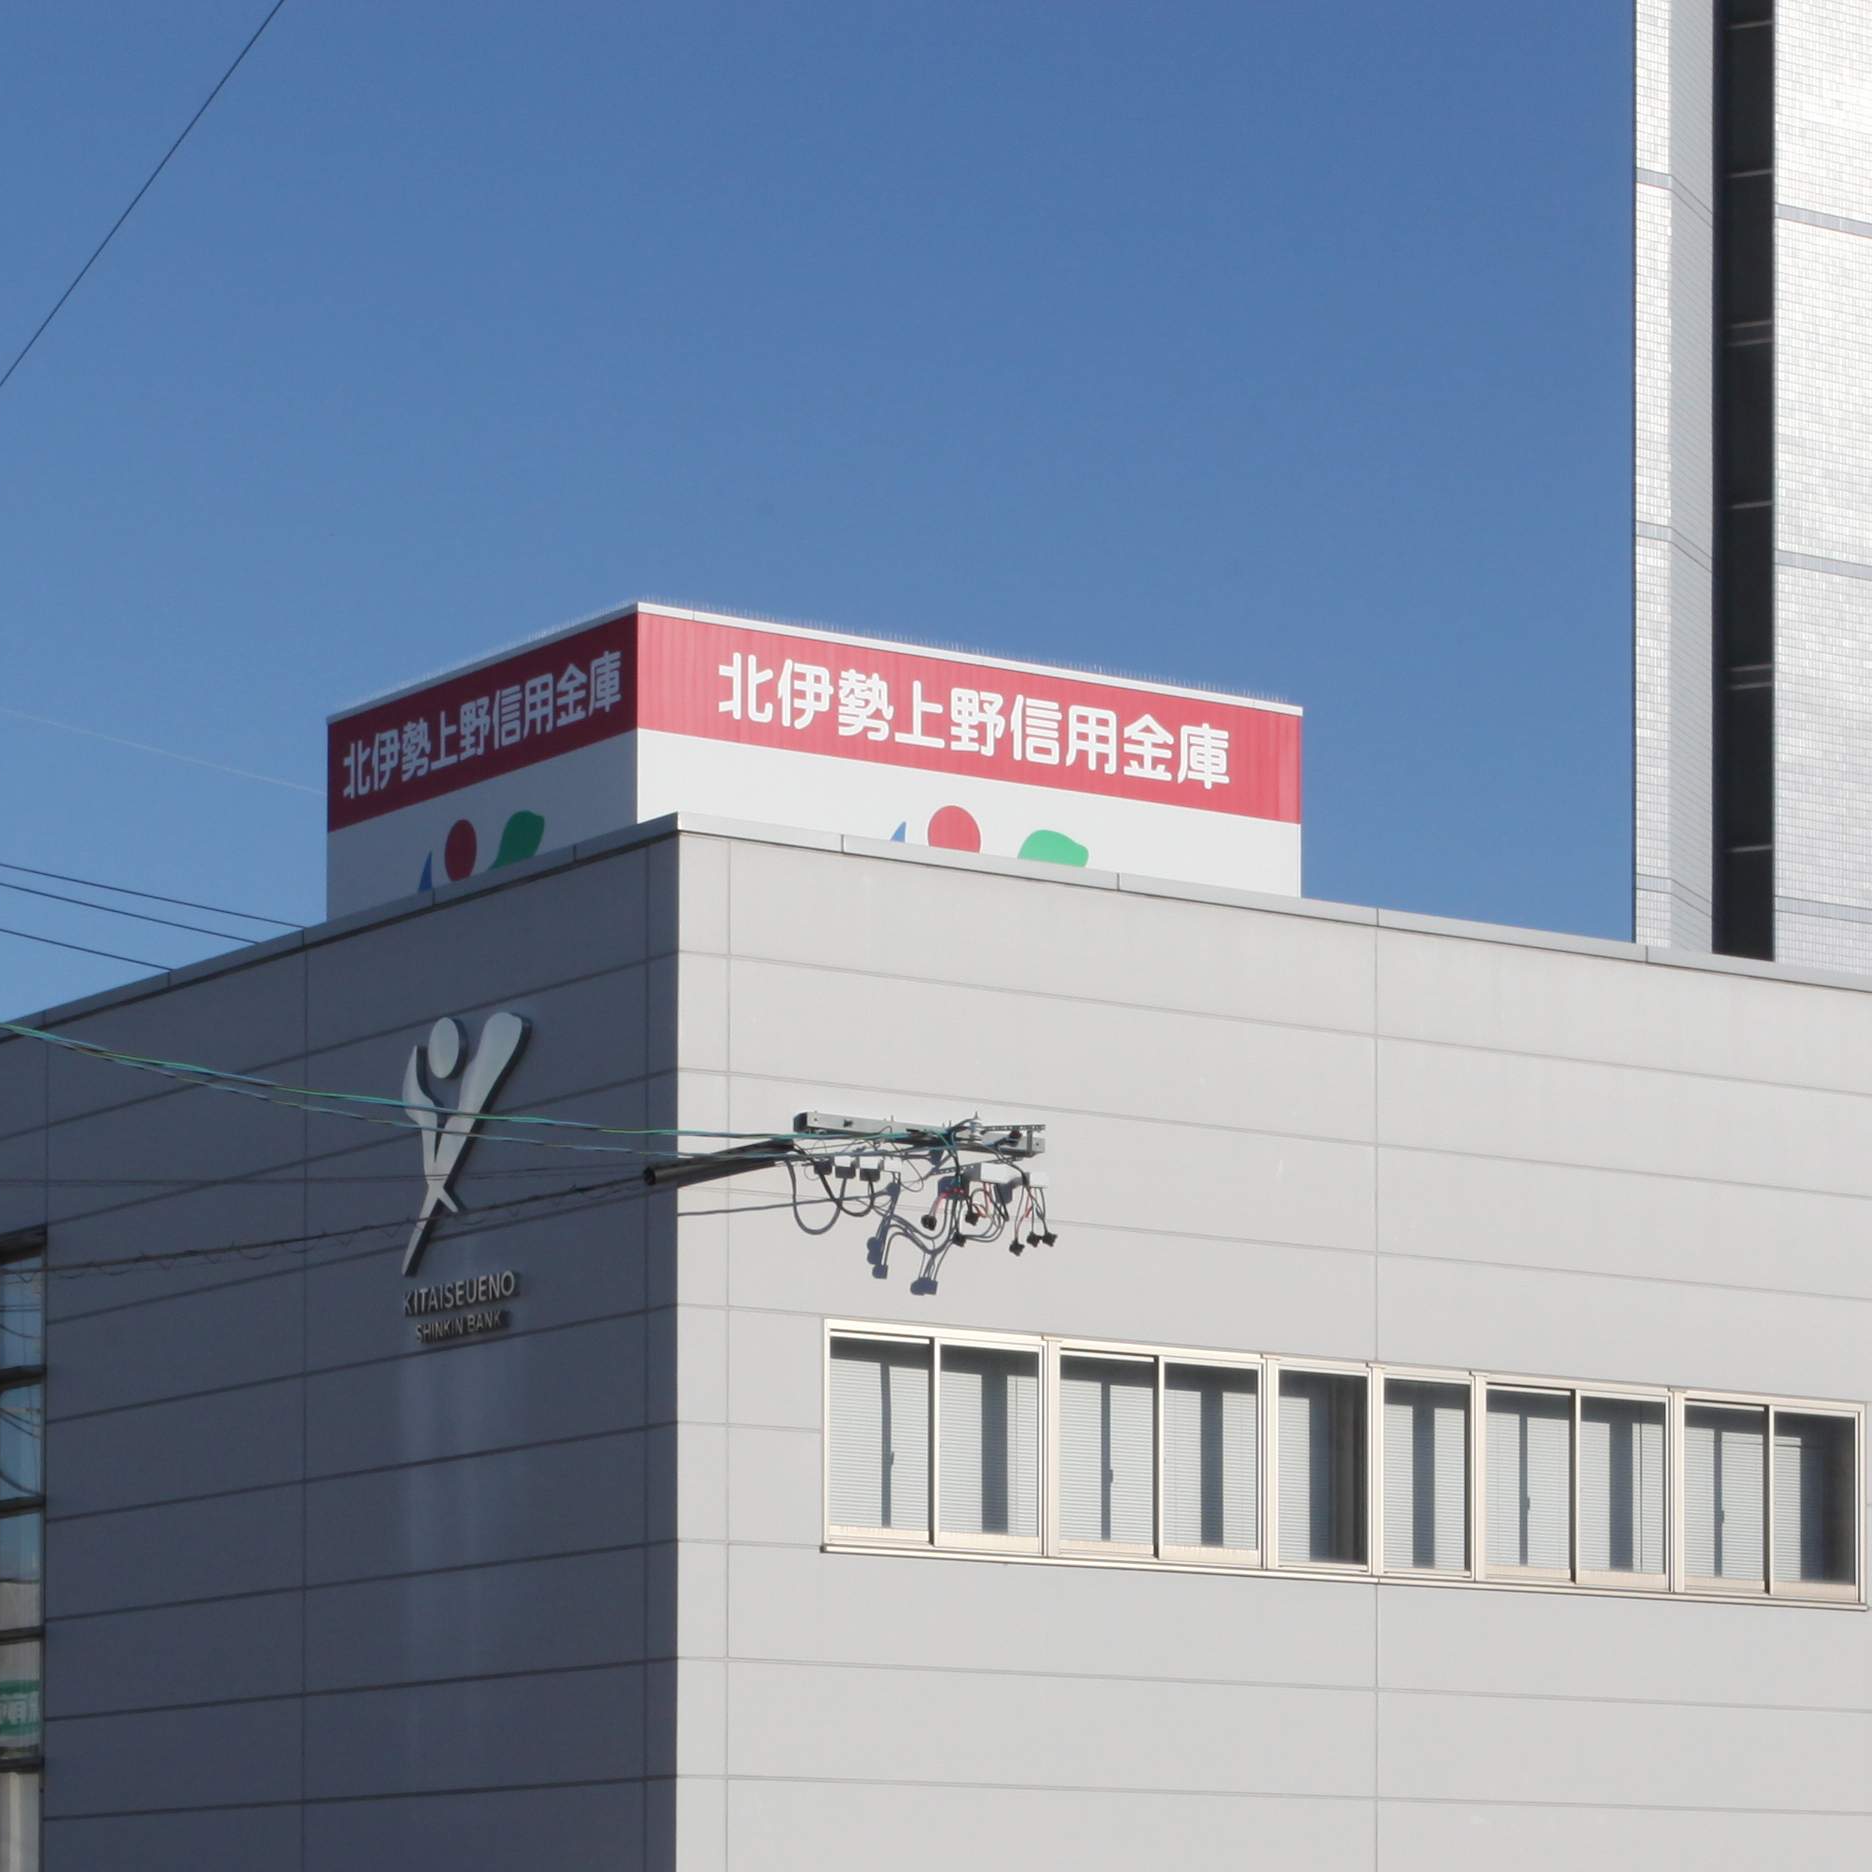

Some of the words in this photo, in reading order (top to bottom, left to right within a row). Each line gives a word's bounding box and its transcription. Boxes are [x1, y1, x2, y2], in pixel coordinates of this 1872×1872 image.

[342, 648, 624, 800] 北伊勢上野信用金庫
[717, 651, 1231, 790] 北伊勢上野信用金庫
[403, 1270, 515, 1316] KITAISEUENO
[415, 1316, 464, 1344] SHINKIN
[467, 1311, 503, 1333] BANK
